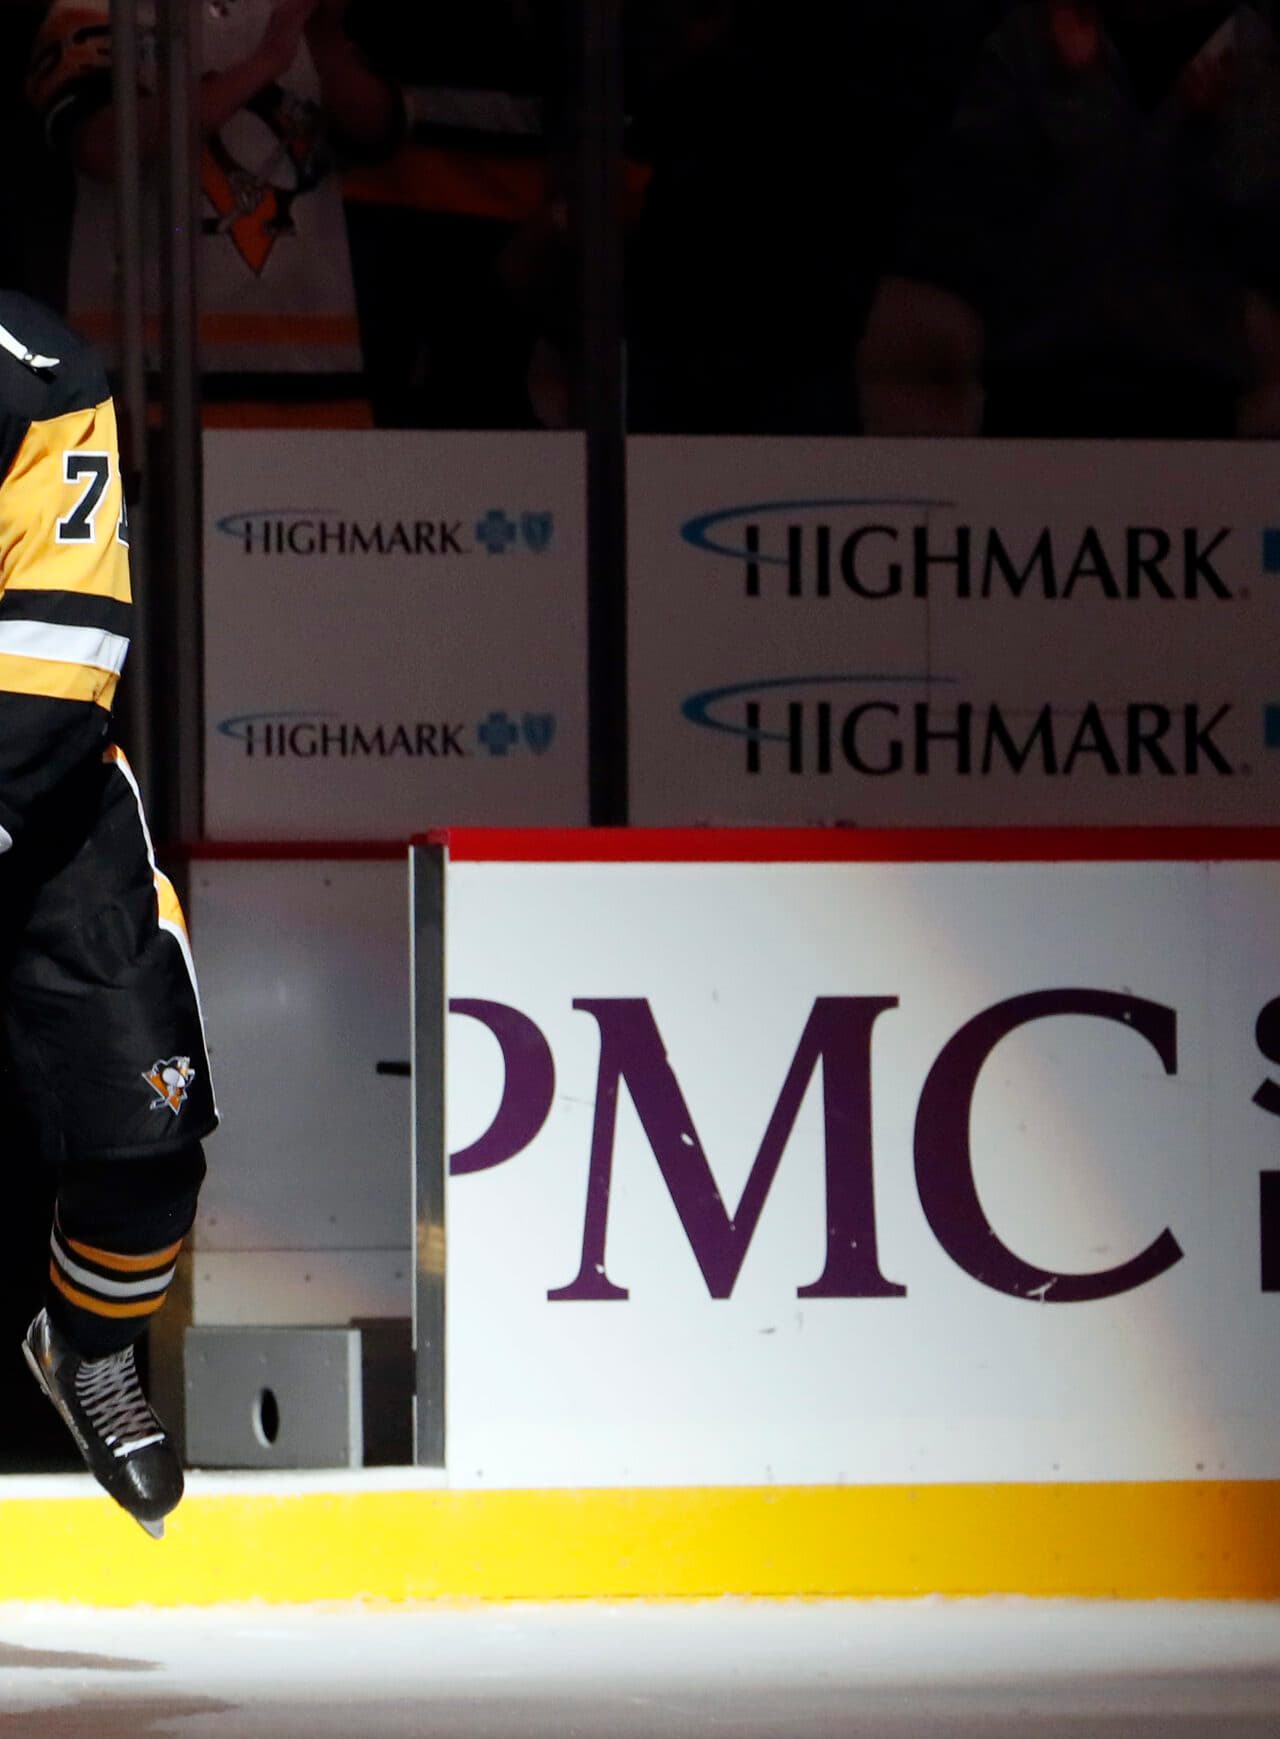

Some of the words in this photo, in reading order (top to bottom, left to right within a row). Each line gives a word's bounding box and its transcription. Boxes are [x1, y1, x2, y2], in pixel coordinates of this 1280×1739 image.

[243, 520, 464, 555] HIGHMARK
[745, 524, 1234, 600] HIGHMARK
[245, 722, 467, 758] HIGHMARK
[745, 701, 1235, 776] HIGHMARK
